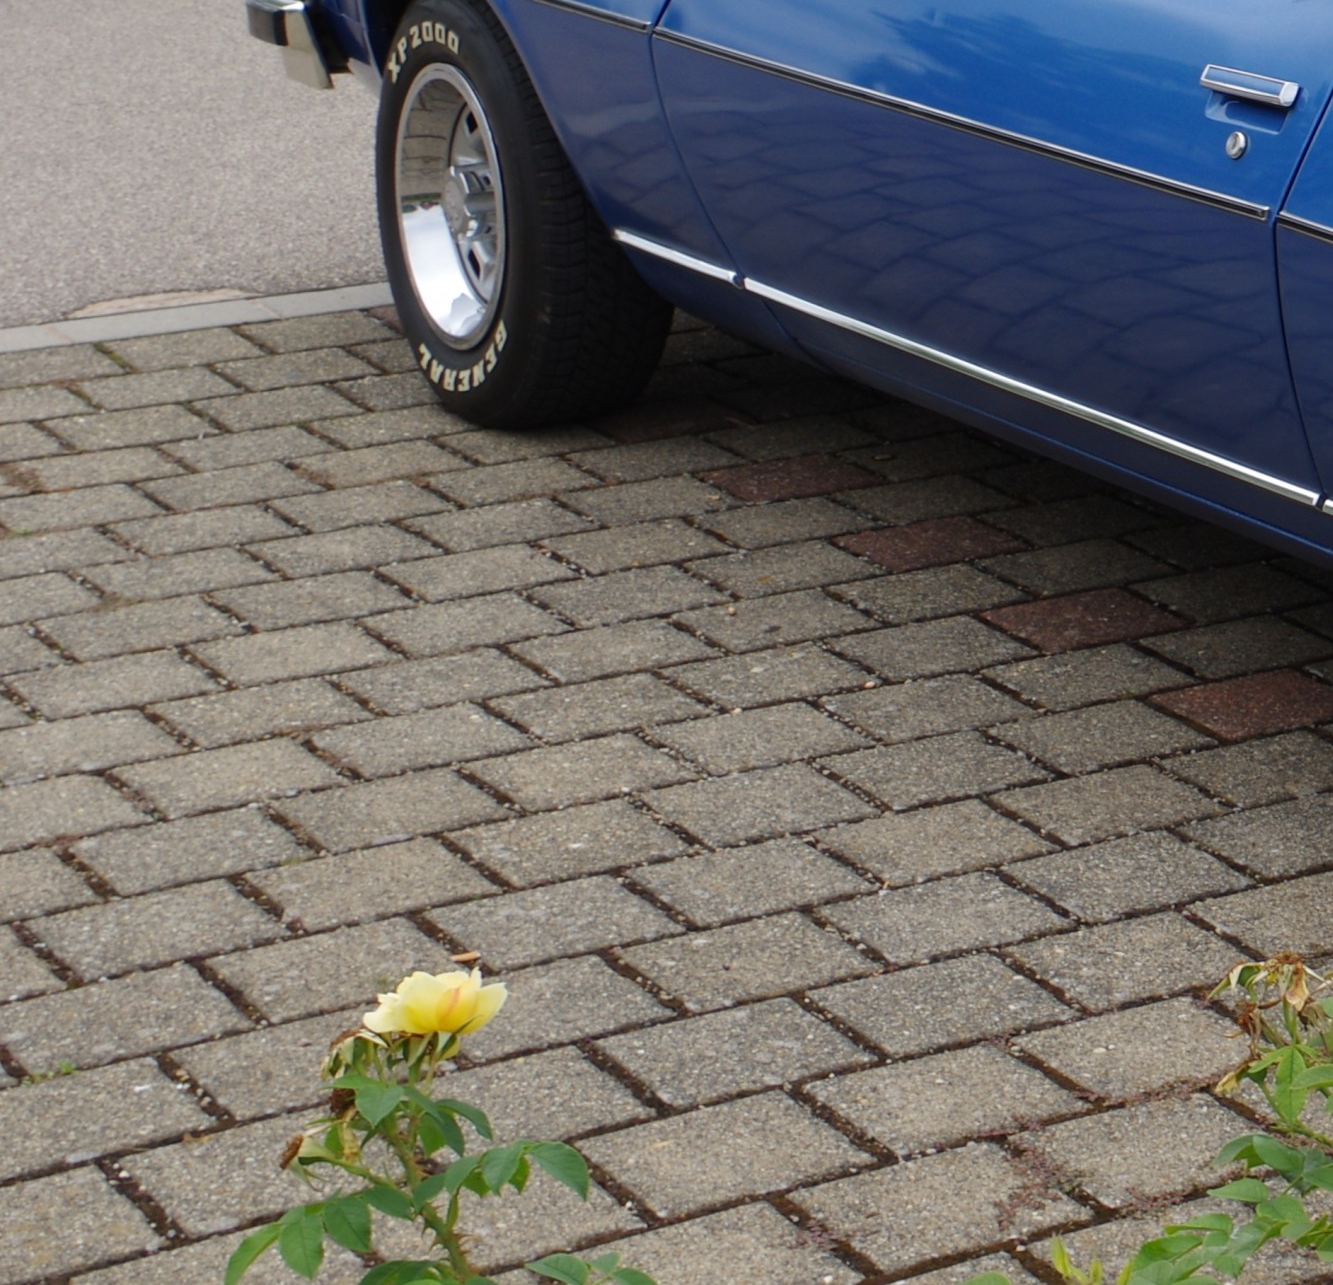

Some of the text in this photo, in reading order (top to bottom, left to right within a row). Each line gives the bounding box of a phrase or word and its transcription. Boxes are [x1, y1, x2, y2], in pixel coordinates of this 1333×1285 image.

[388, 20, 459, 84] XP 2000
[419, 319, 507, 392] GENERAL
